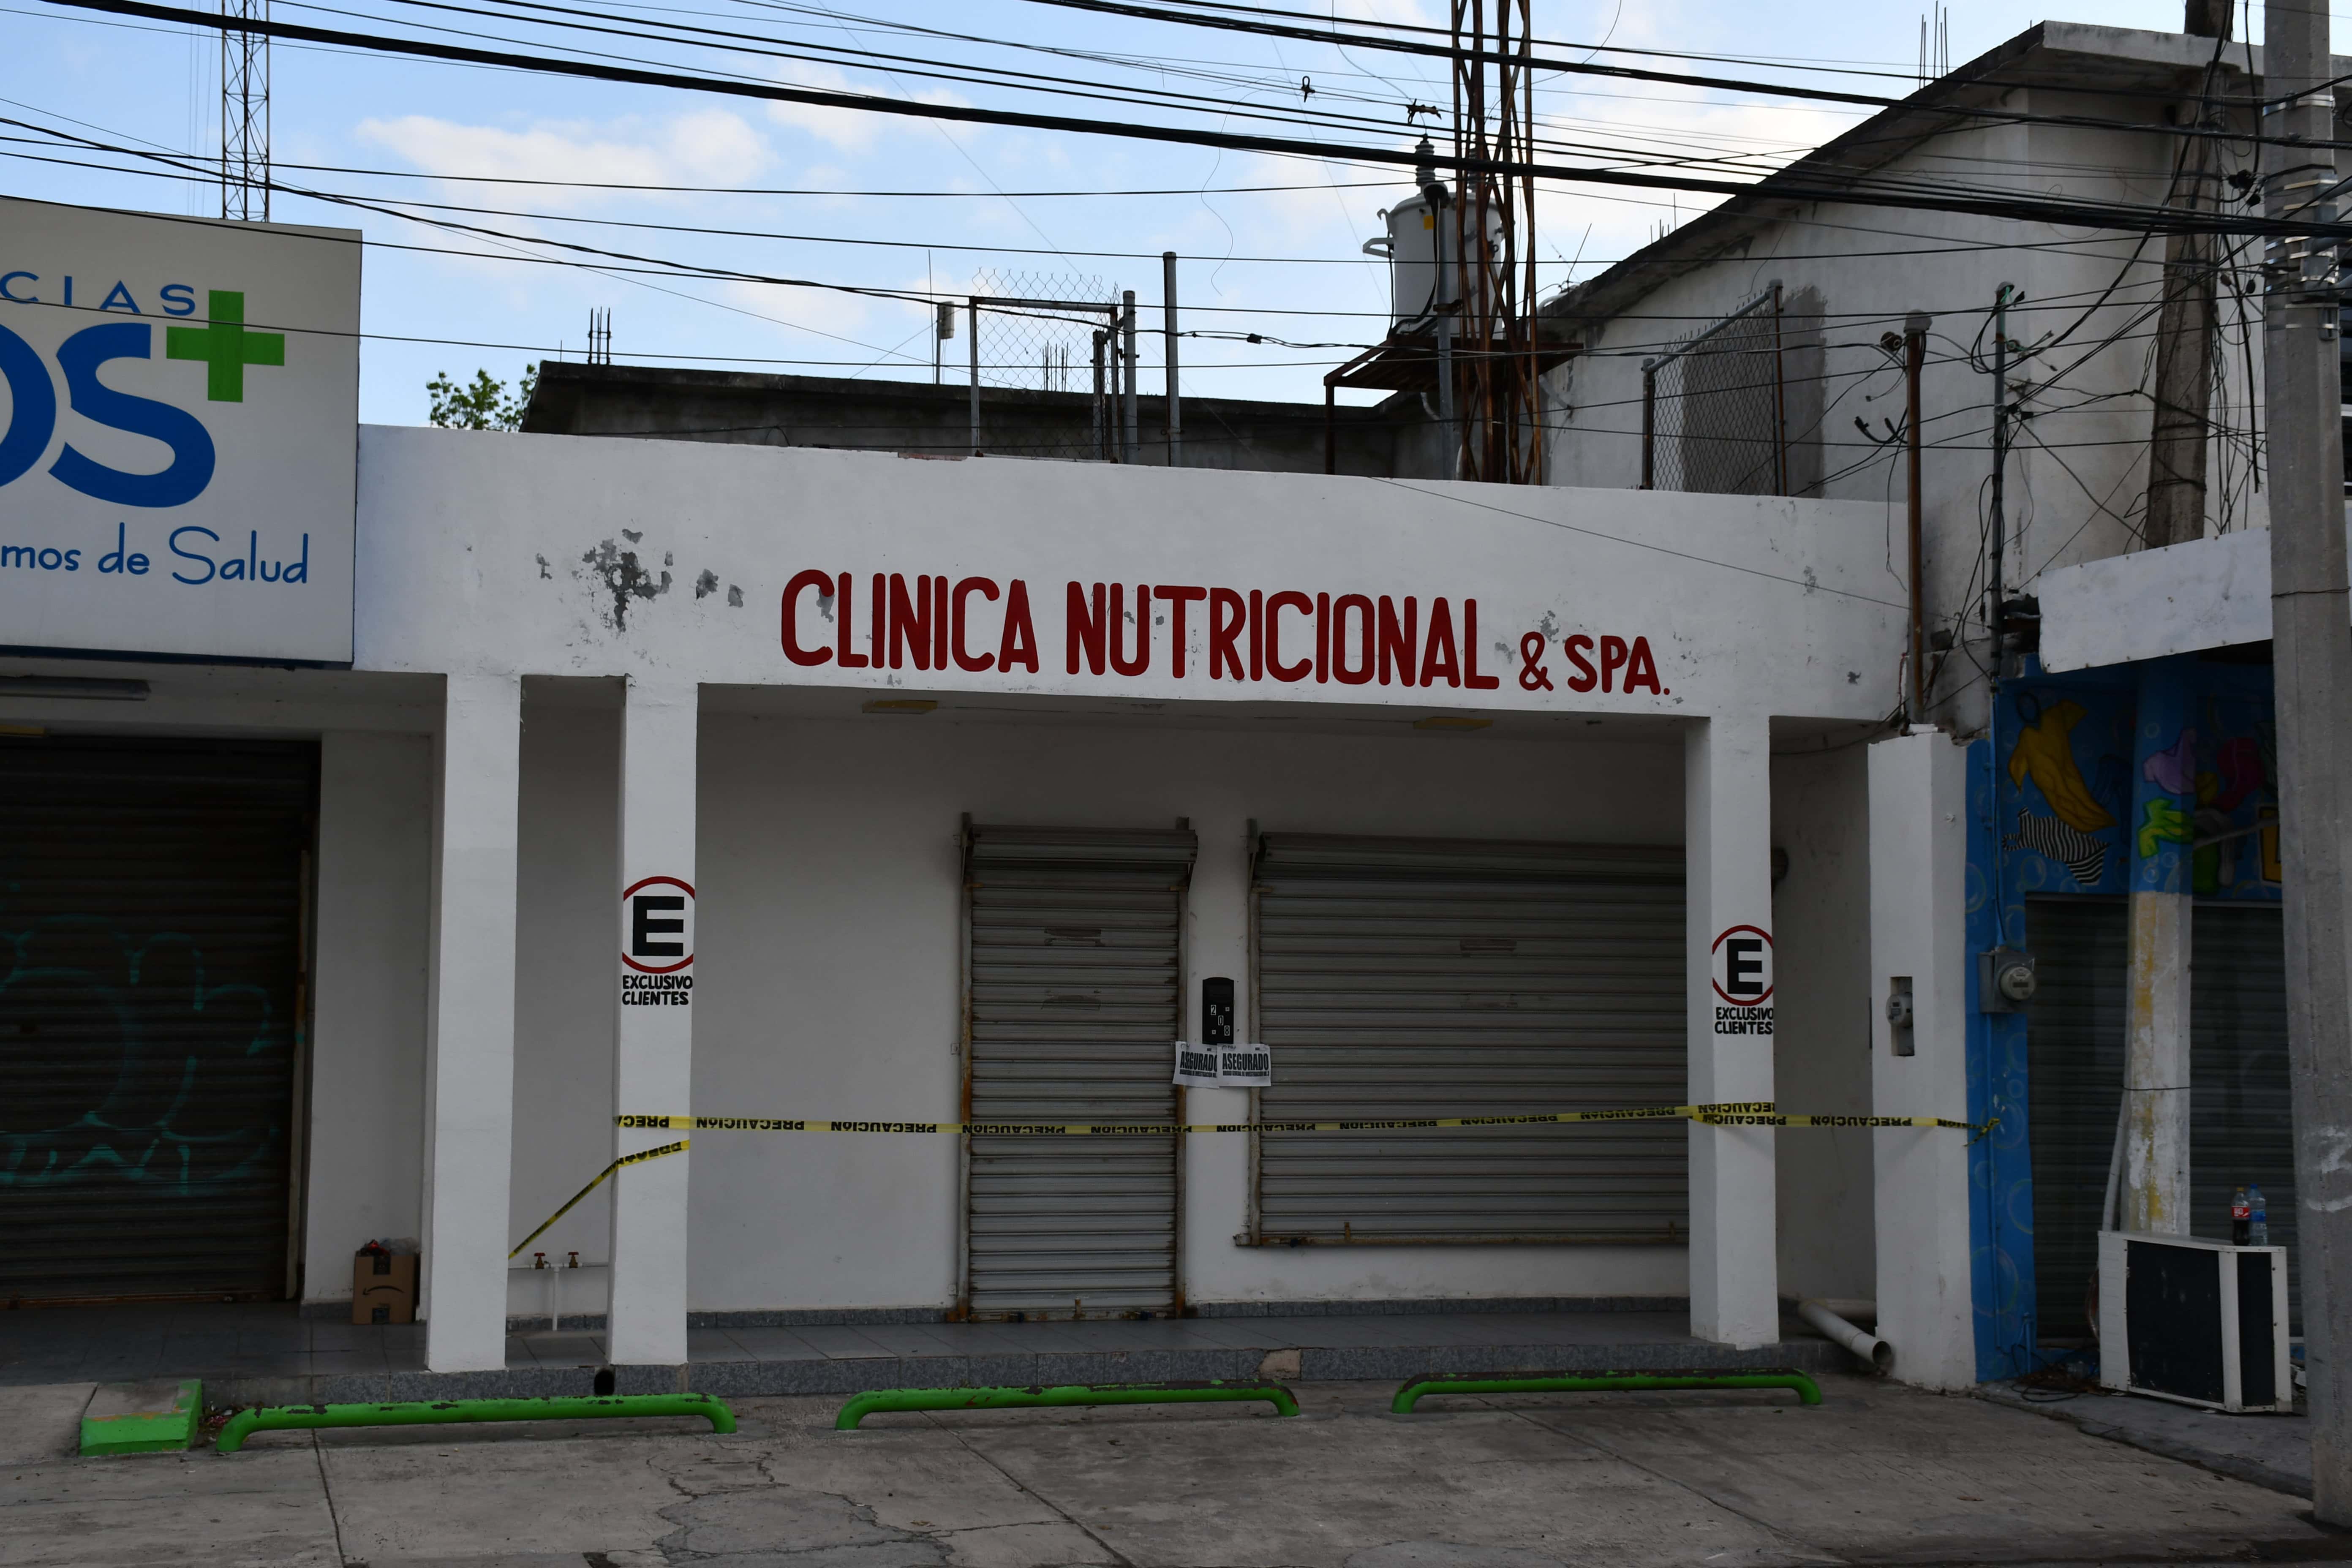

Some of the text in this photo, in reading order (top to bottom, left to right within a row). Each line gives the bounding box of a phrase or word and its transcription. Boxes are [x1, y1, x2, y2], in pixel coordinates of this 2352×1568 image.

[0, 271, 196, 316] CIAS
[0, 522, 309, 585] mos de Salud
[781, 569, 1670, 695] CLINICA NUTRICIONAL & SPA.
[633, 896, 684, 956] E
[1727, 939, 1763, 994] E
[622, 991, 689, 1005] CLIENTES
[623, 975, 693, 990] EXCLUSIVO
[1715, 1021, 1773, 1035] CLIENTES
[1716, 1007, 1774, 1020] EXCLUSIVO
[1222, 1053, 1269, 1070] ASEGURADO
